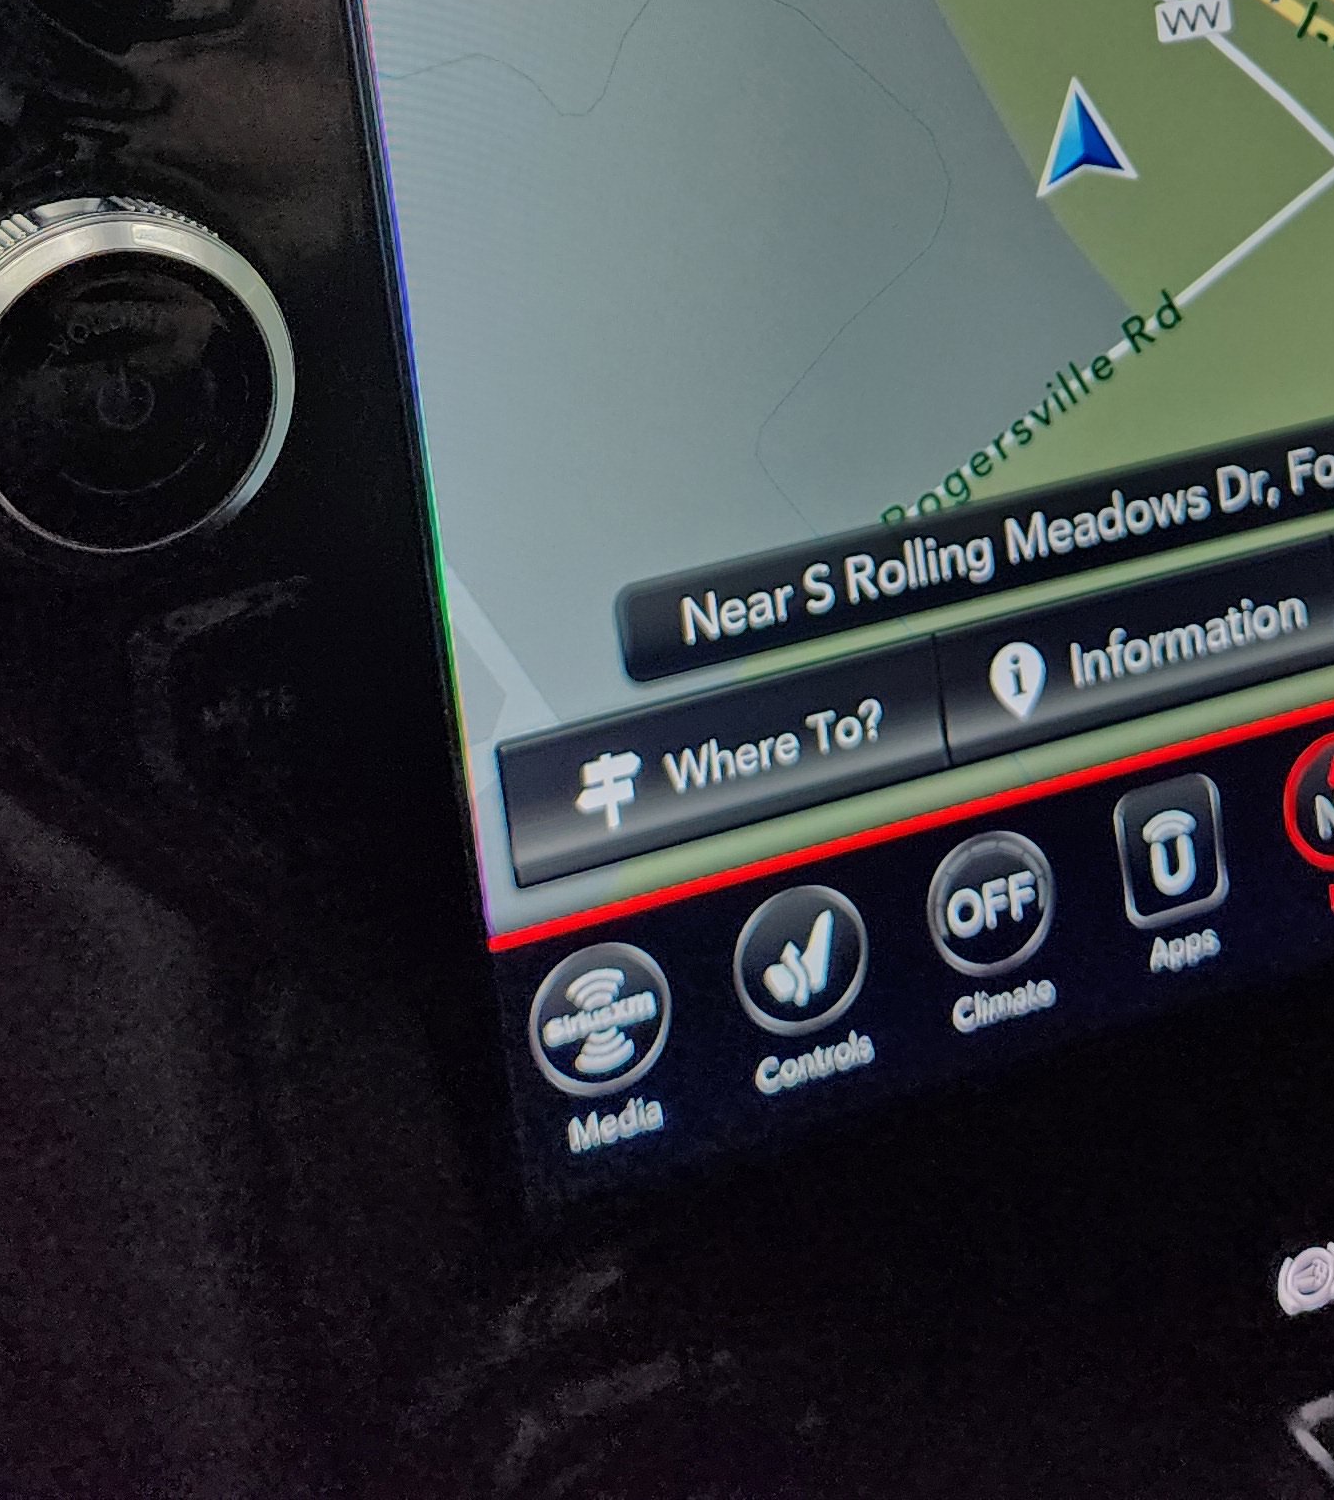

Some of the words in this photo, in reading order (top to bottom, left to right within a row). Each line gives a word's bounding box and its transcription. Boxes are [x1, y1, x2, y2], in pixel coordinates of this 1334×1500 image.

[1121, 290, 1184, 353] Rd
[680, 580, 794, 646] Near
[803, 563, 835, 614] S
[845, 537, 994, 604] Rolling
[1004, 489, 1210, 565] Meadows
[1216, 465, 1281, 512] Dr,
[1070, 599, 1309, 688] Information
[664, 729, 800, 793] Where
[805, 699, 883, 755] To?
[947, 870, 1037, 938] OFF
[1149, 929, 1221, 973] Apps
[952, 980, 1057, 1033] Climate
[755, 1030, 875, 1094] Controls
[569, 1098, 663, 1153] Media
